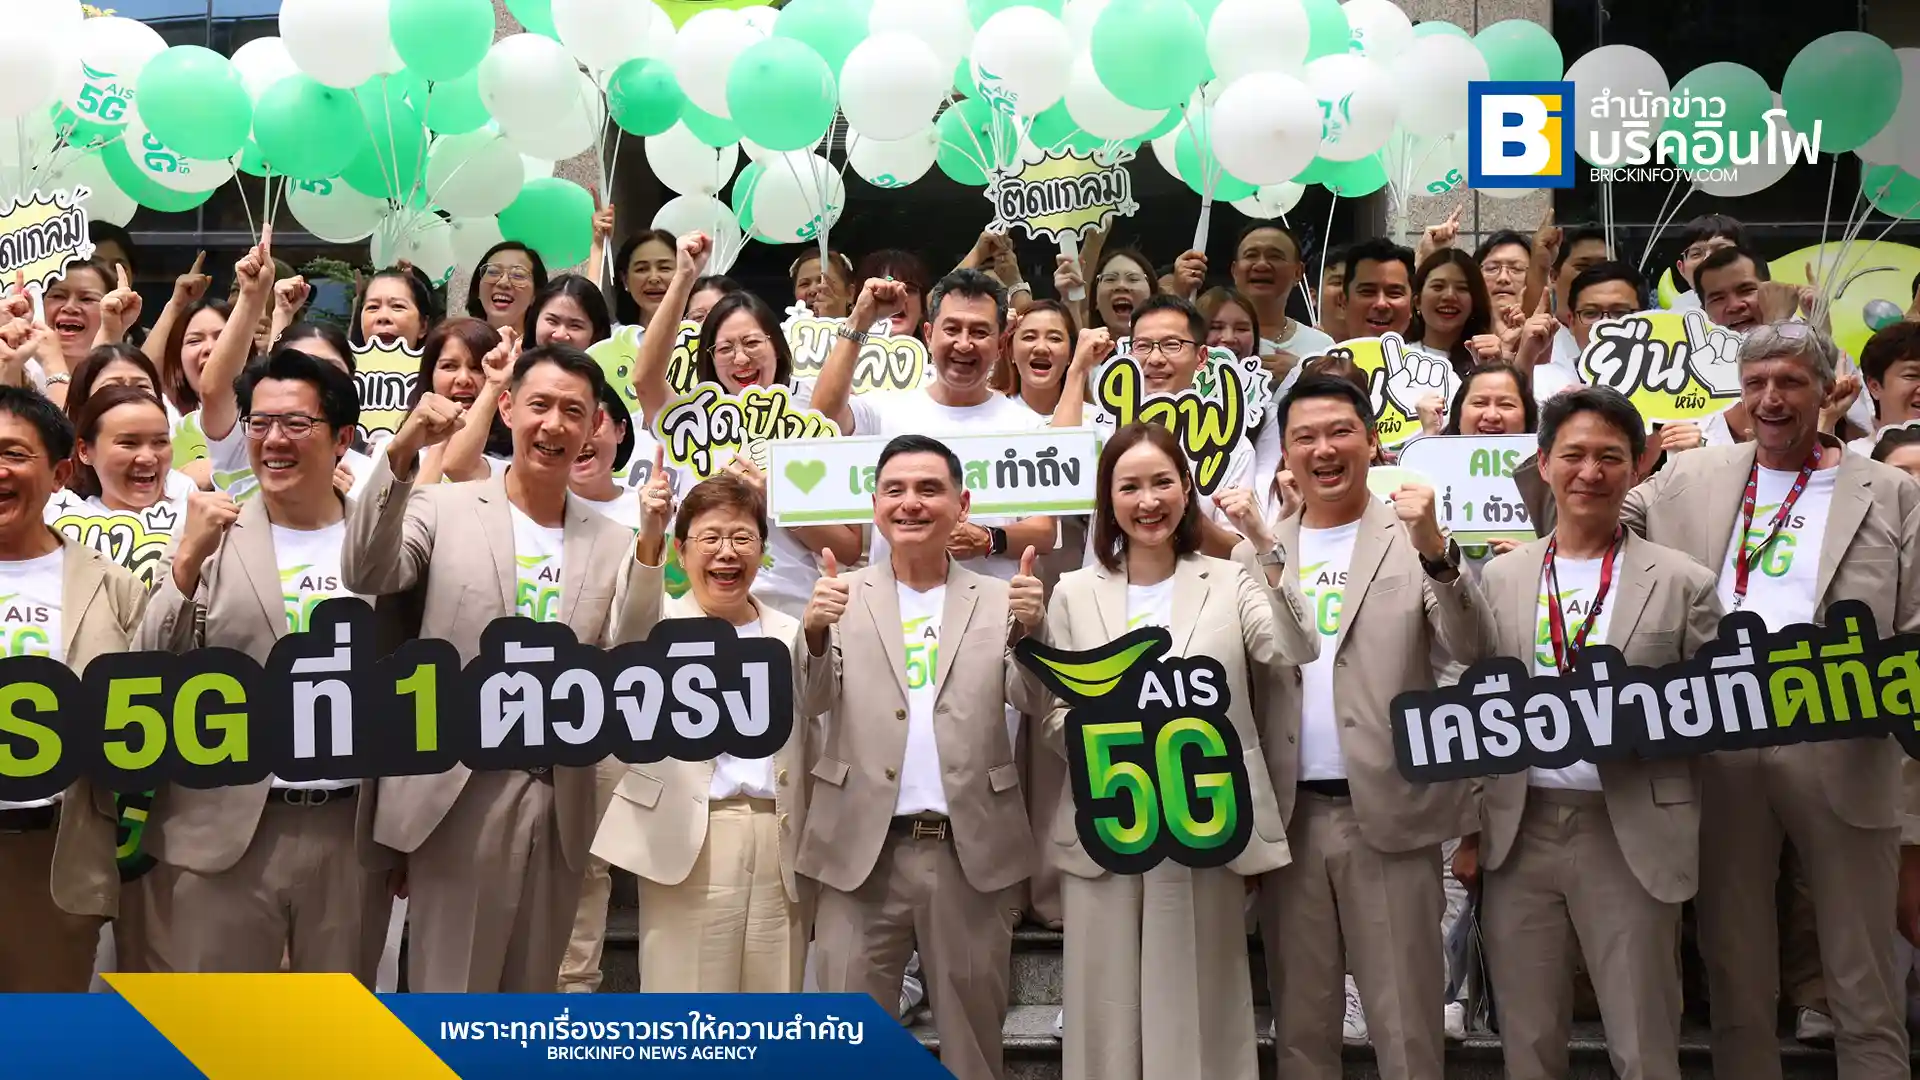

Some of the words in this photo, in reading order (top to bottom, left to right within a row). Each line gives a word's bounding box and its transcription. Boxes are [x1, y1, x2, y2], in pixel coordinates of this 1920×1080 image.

[77, 83, 127, 121] 5G
[105, 84, 134, 99] AIS
[1001, 170, 1123, 217] ติดแกลม
[1587, 319, 1691, 397] ยืน
[1675, 388, 1706, 409] หนึ่ง
[1469, 448, 1520, 479] AIS
[1462, 501, 1473, 521] 1
[1483, 494, 1532, 523] ตัวจ
[300, 575, 338, 591] AIS
[5, 605, 49, 622] AIS
[103, 672, 249, 769] 5G
[290, 622, 354, 759] ที่
[396, 663, 438, 752] 1
[480, 641, 770, 749] ตัวจริง
[1137, 668, 1219, 709] AIS
[1081, 716, 1238, 855] 5G
